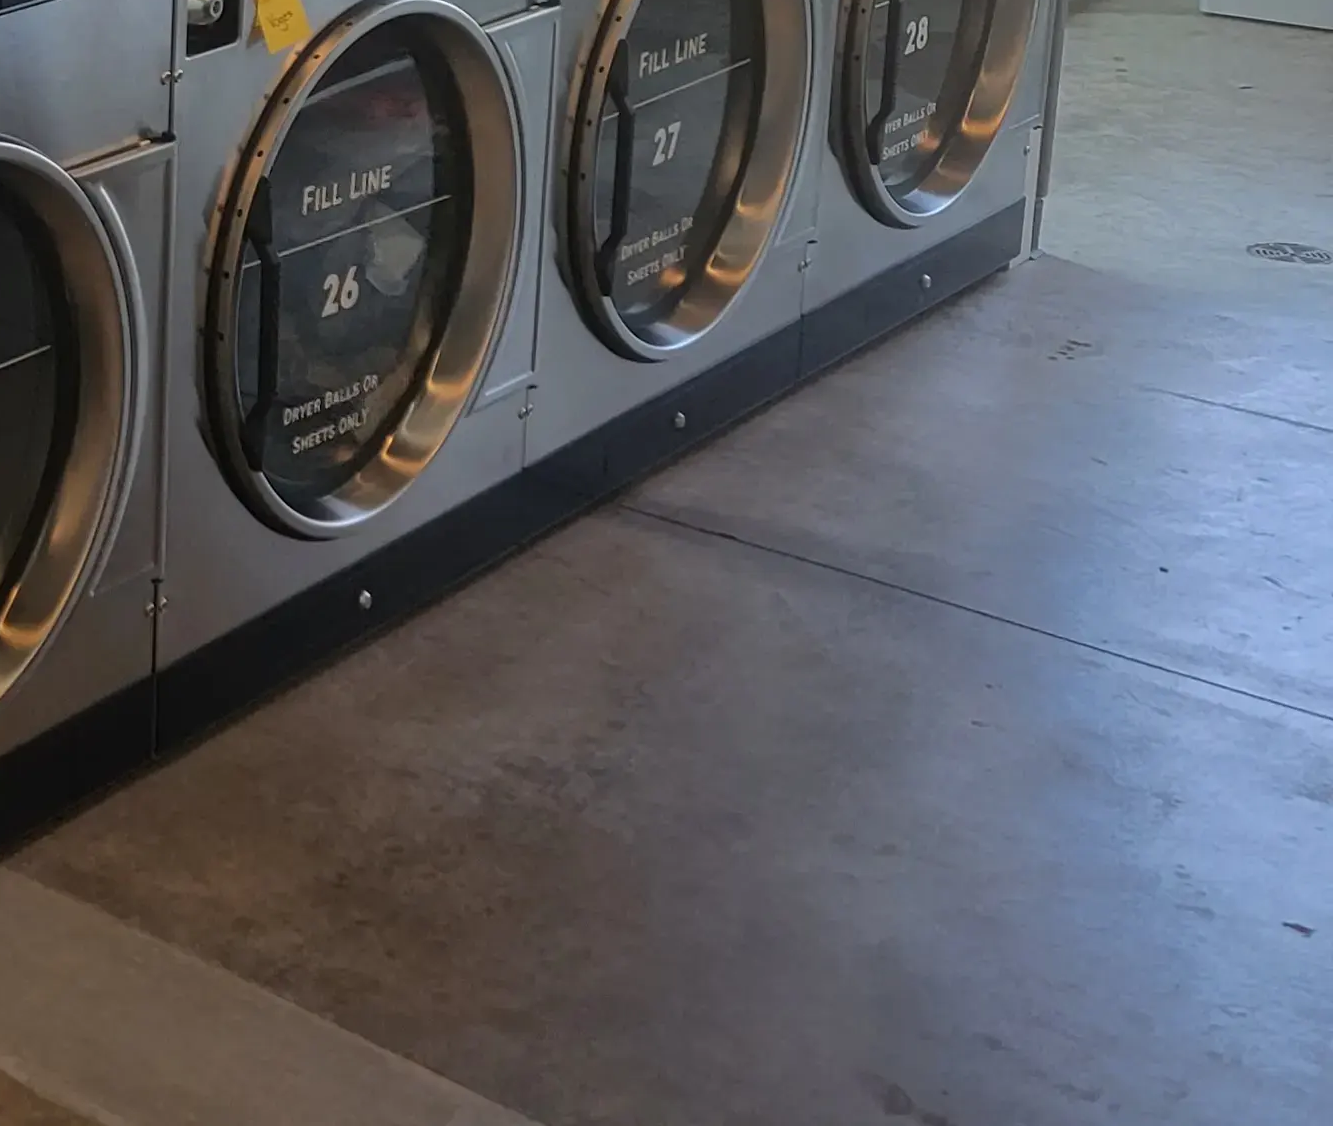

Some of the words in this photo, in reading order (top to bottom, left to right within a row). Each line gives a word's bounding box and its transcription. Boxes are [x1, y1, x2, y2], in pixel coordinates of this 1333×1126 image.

[639, 47, 670, 78] FILL
[675, 32, 708, 64] LINE
[904, 16, 929, 56] 28
[652, 121, 682, 166] 27
[301, 182, 343, 216] FILL
[349, 164, 393, 201] LINE
[321, 265, 360, 318] 26
[283, 396, 322, 426] DRYER
[324, 382, 360, 411] BALLS
[363, 374, 379, 395] OR
[291, 423, 335, 455] SHEETS
[338, 407, 371, 434] ONLY
